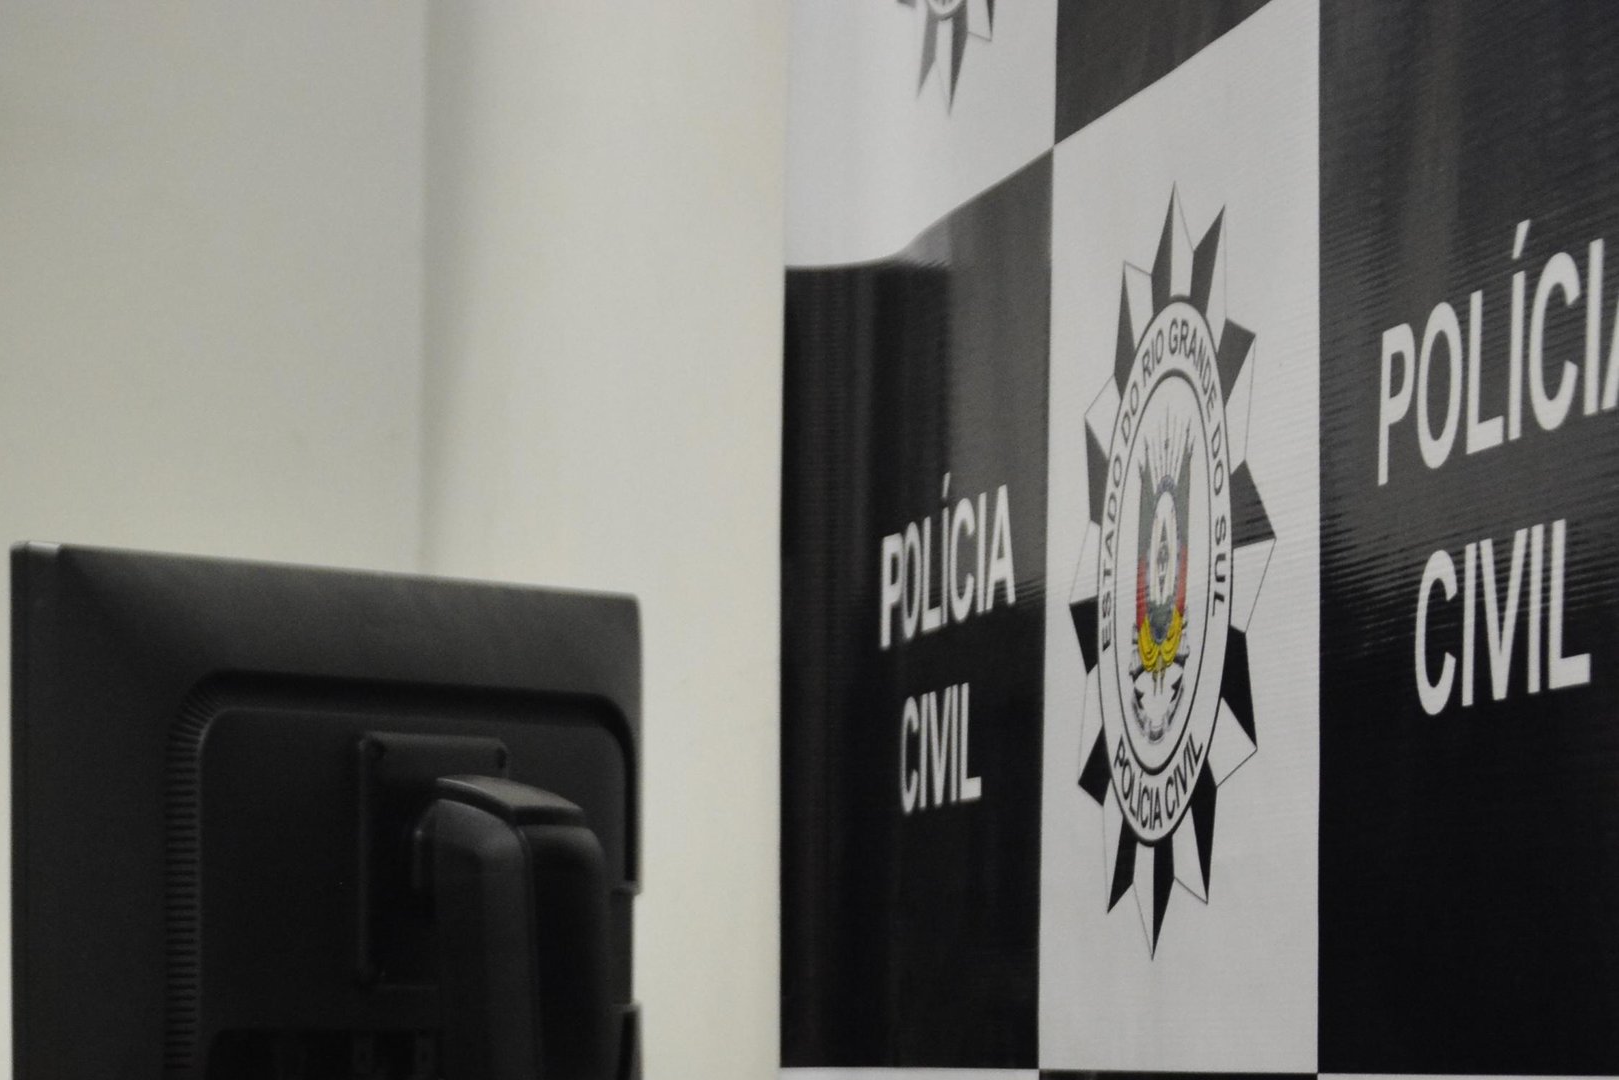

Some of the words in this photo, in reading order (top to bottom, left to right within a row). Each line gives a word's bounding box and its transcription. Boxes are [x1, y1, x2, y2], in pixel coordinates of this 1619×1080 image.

[1142, 328, 1164, 388] RIO
[1168, 317, 1217, 423] GRANDE
[1120, 380, 1139, 446] DO
[1211, 421, 1224, 496] DO
[880, 471, 1016, 649] POLÍCIA
[1102, 454, 1123, 652] ESTADO
[1212, 514, 1227, 617] SUL
[1414, 518, 1591, 716] CIVIL
[899, 682, 982, 814] CIVIL
[1114, 733, 1162, 831] POLÍCIA
[1165, 732, 1203, 820] CIVIL
